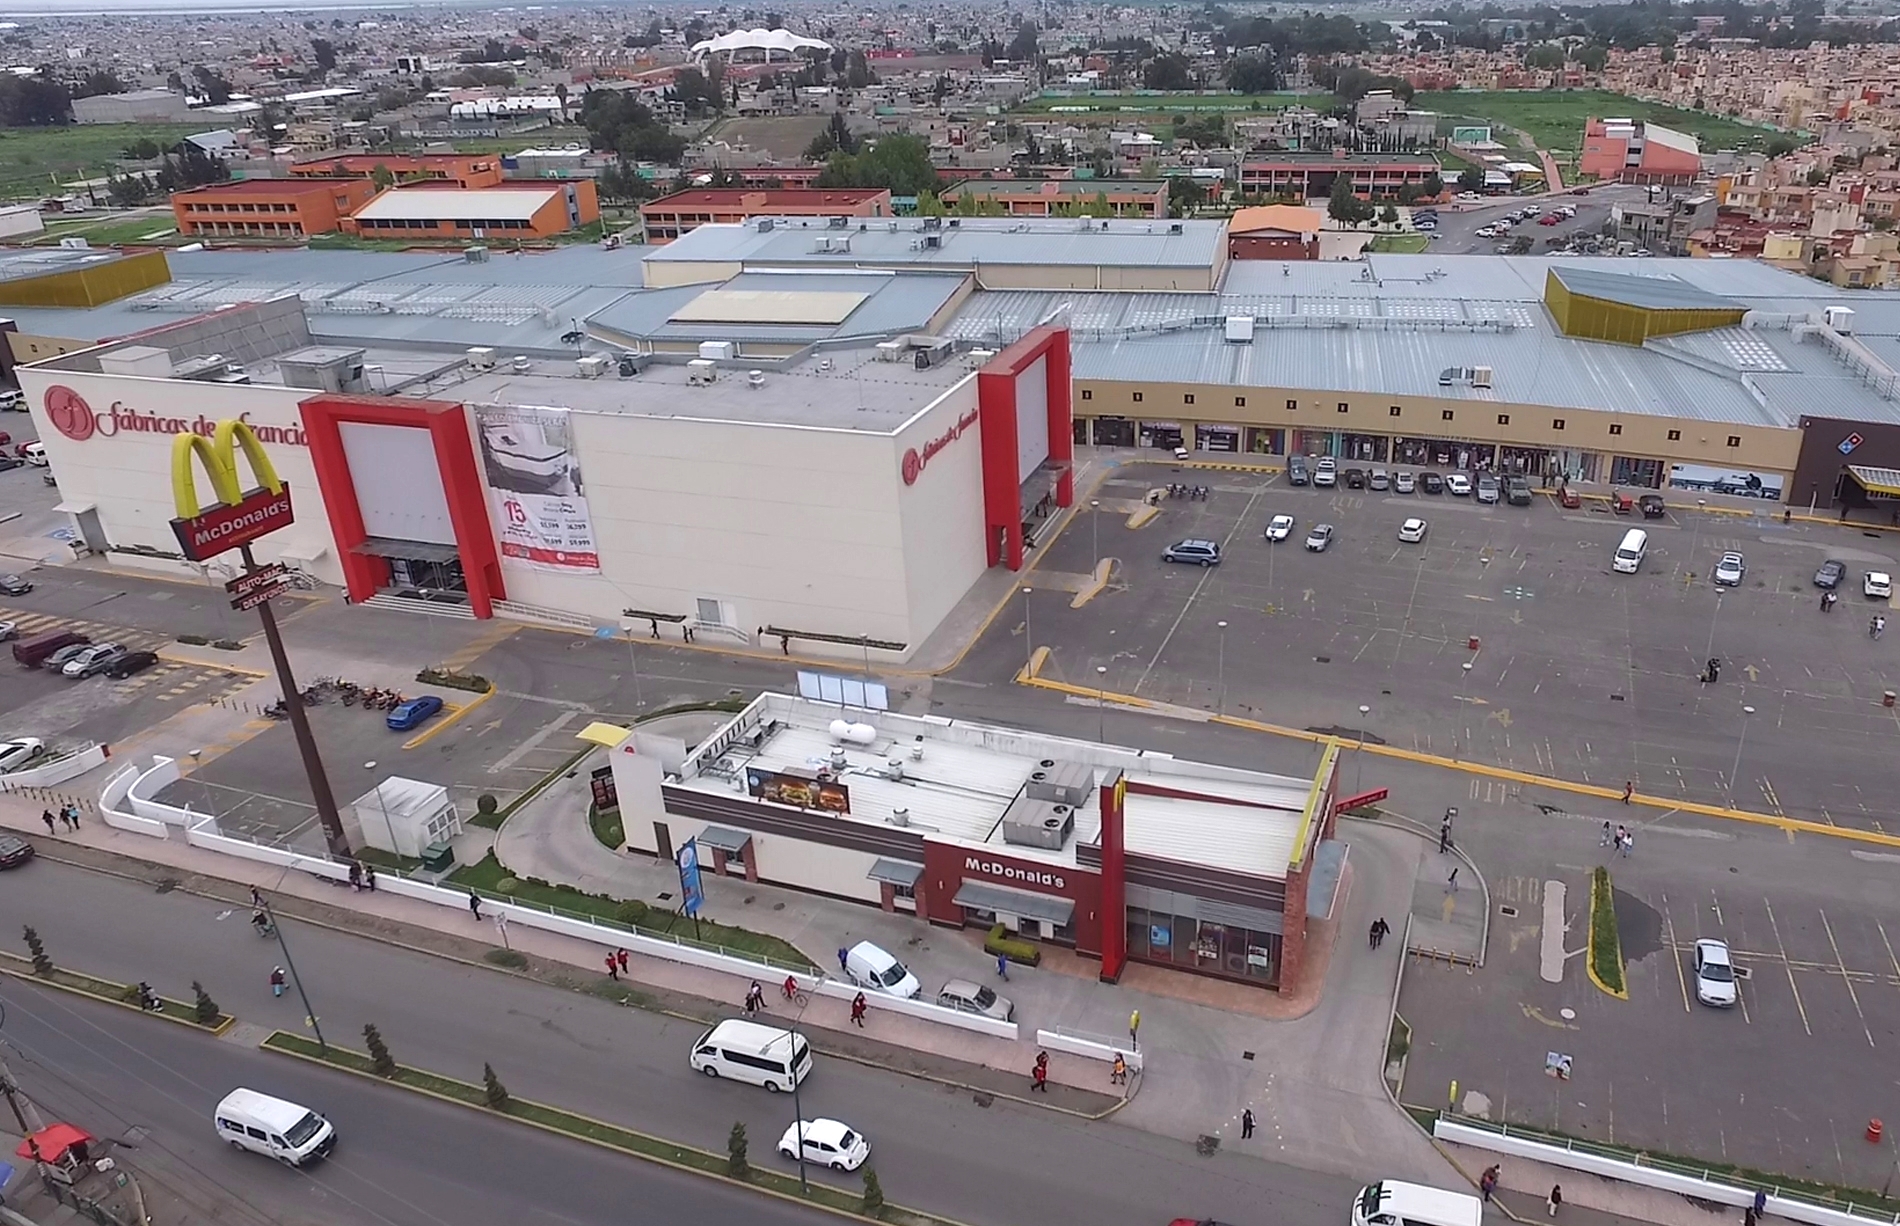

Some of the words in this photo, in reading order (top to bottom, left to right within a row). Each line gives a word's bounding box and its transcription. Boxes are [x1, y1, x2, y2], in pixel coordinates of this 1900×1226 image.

[192, 415, 216, 438] de
[194, 499, 290, 547] McDonald's
[238, 566, 283, 592] AUTO-MAC
[242, 582, 289, 609] DESAYUNOS
[964, 856, 1066, 889] McDonald's
